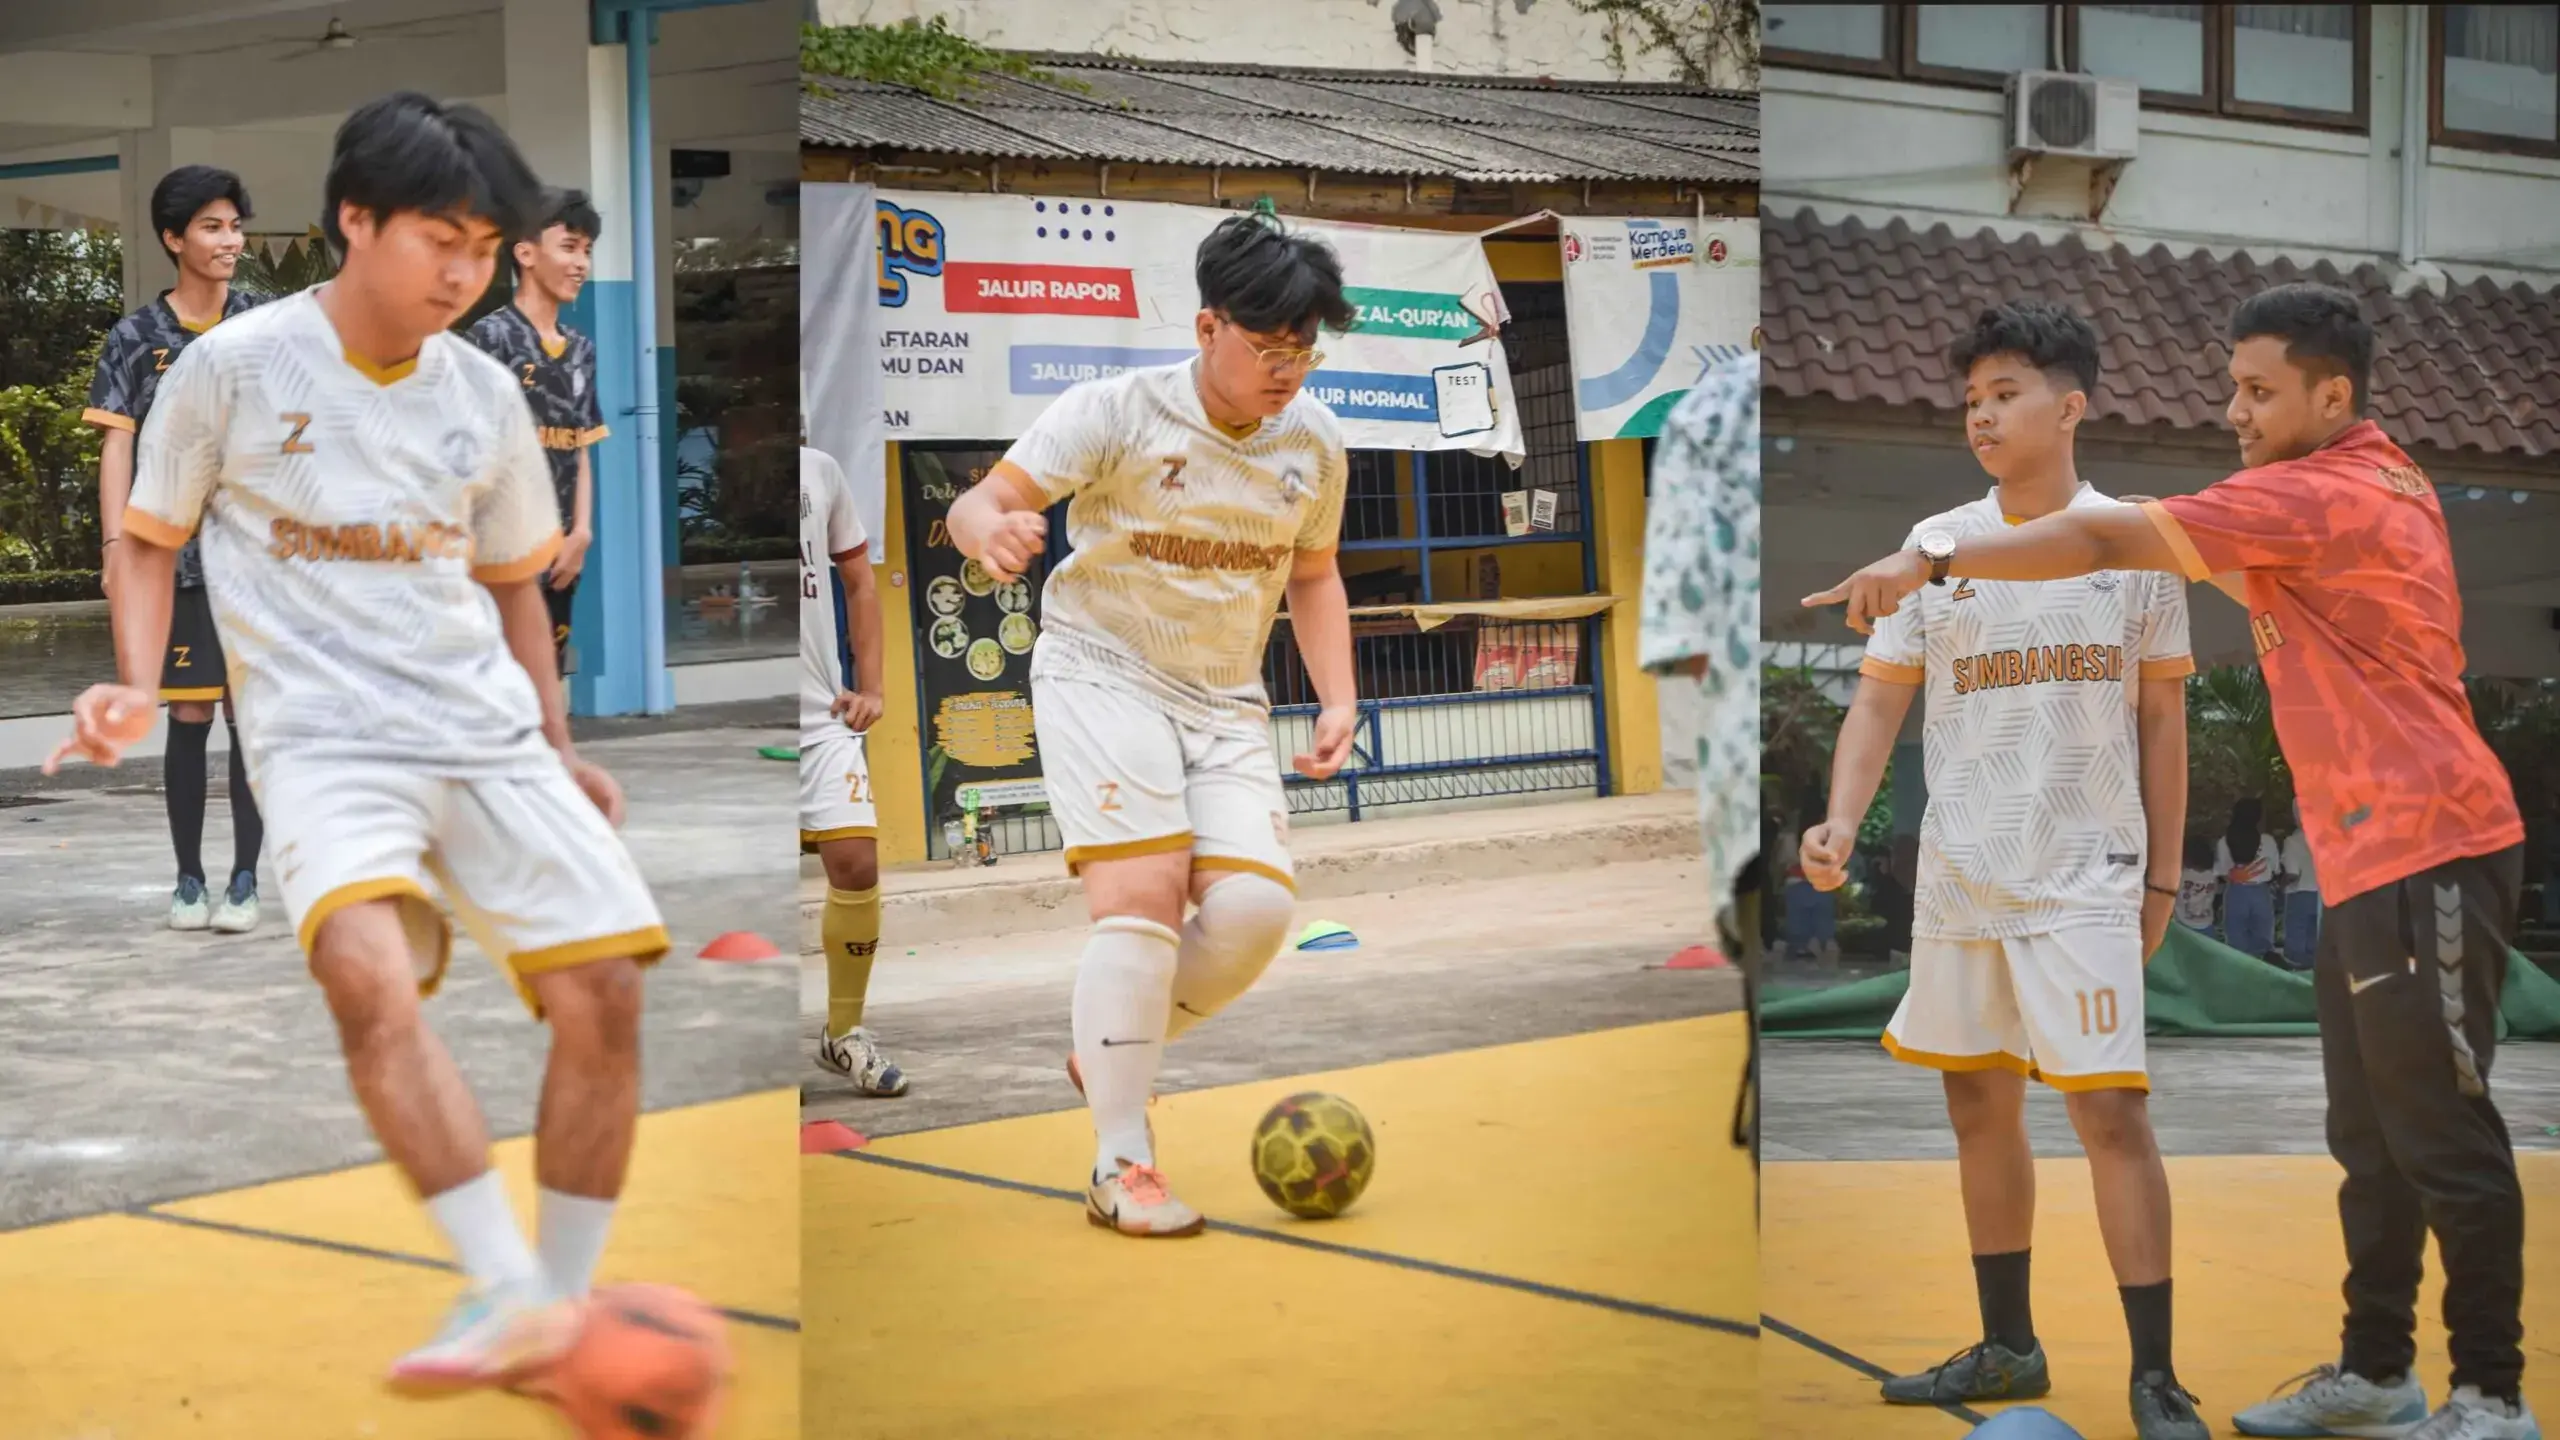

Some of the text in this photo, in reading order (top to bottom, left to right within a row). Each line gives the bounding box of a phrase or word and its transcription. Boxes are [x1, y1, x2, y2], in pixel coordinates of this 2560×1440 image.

[1629, 228, 1687, 246] Kampus
[1631, 241, 1694, 260] Merdeka
[977, 279, 1121, 301] JALUR RAPOR
[880, 331, 969, 348] FTARAN
[917, 357, 964, 374] DAN
[1030, 363, 1098, 382] JALUR
[1448, 375, 1478, 386] TEST
[1349, 388, 1430, 409] NORMAL
[279, 412, 315, 455] Z
[1160, 457, 1187, 490] Z
[2075, 987, 2118, 1036] 10
